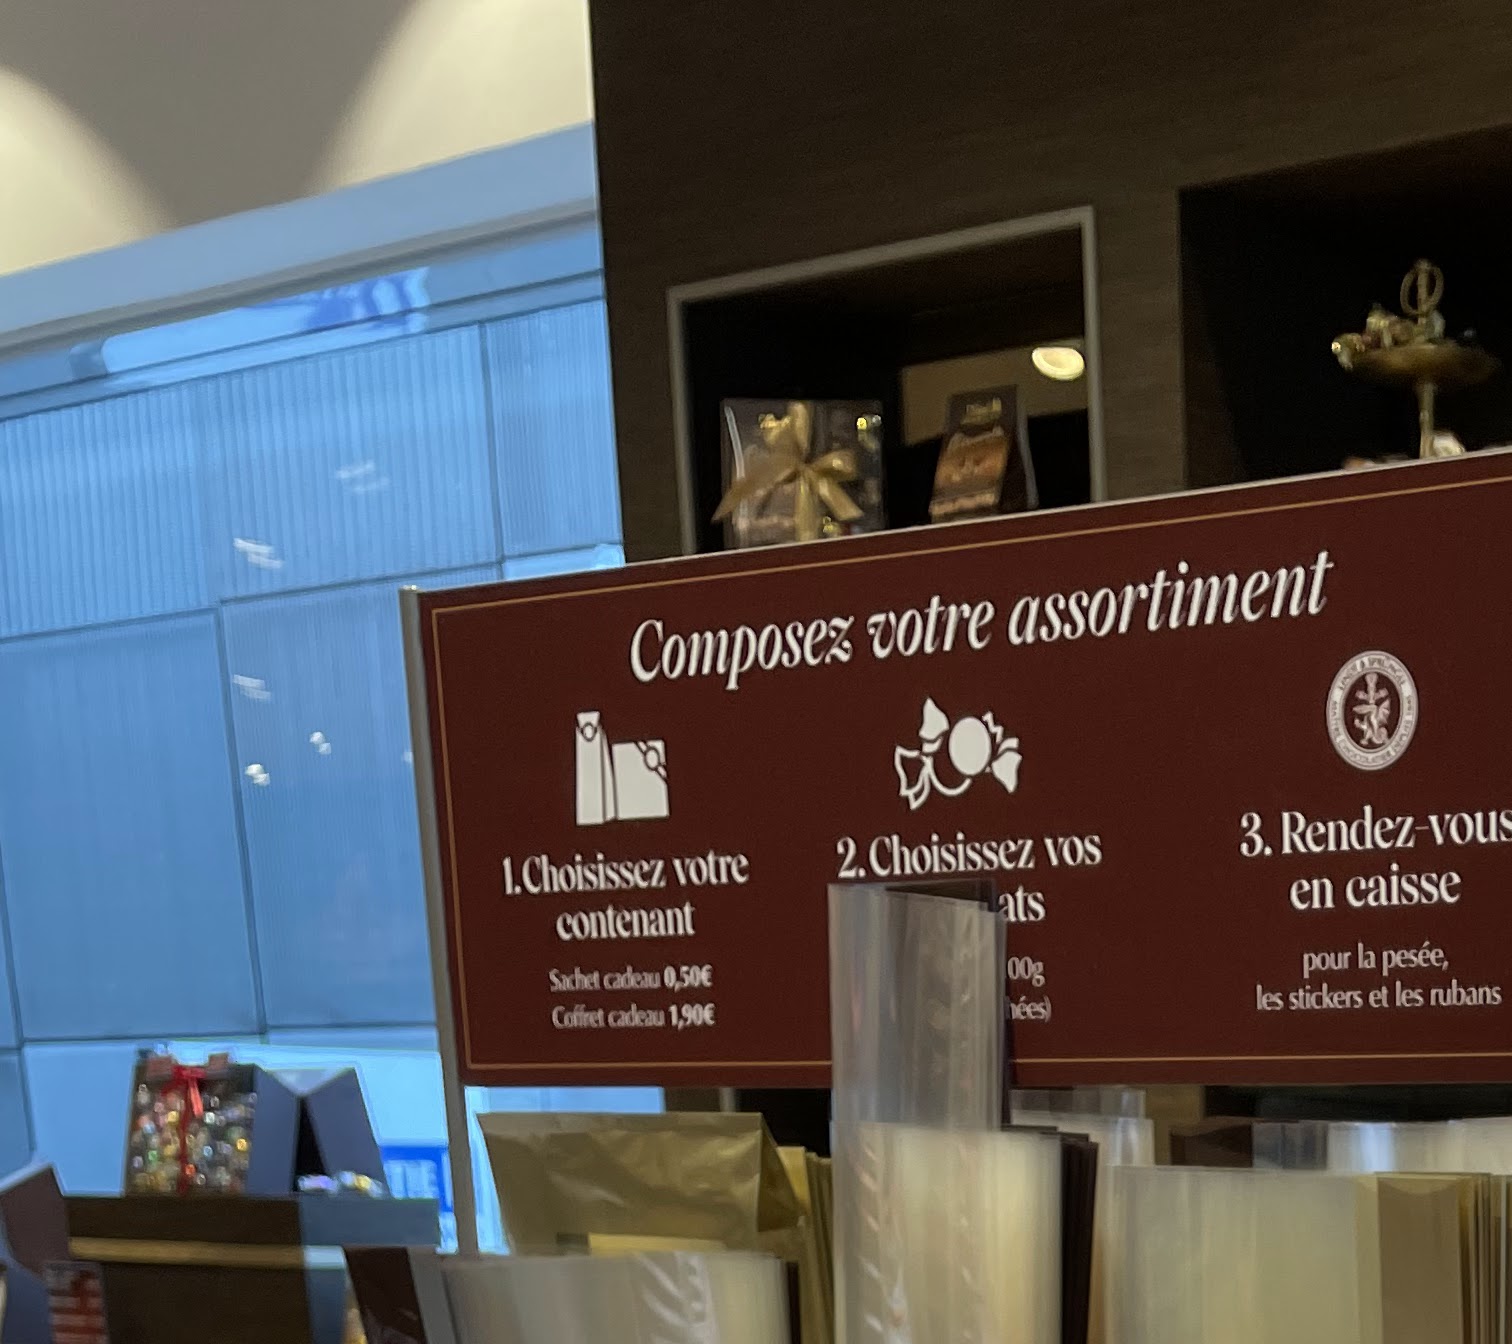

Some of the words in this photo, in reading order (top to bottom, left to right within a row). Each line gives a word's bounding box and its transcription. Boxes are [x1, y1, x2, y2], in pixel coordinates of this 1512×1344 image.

[630, 614, 853, 690] Composez
[867, 595, 995, 659] votre
[1007, 551, 1334, 645] assortiment
[1044, 835, 1102, 867] vos
[1240, 812, 1272, 857] 3.
[672, 849, 750, 885] votre
[1290, 876, 1335, 910] en
[1345, 862, 1461, 907] caisse
[556, 900, 696, 941] contenant
[549, 966, 600, 992] Sachet
[603, 965, 661, 990] cadeau
[663, 964, 713, 992] 0,50€
[1304, 951, 1351, 979] pour
[1358, 943, 1376, 969] la
[1382, 940, 1449, 977] pesée,
[1257, 984, 1284, 1011] les
[1289, 982, 1364, 1010] stickers
[1369, 986, 1389, 1008] et
[1395, 981, 1423, 1007] les
[1430, 979, 1502, 1007] rubans
[552, 1003, 605, 1030] Coffret
[608, 1003, 665, 1028] cadeau
[668, 1003, 716, 1031] 1,90€
